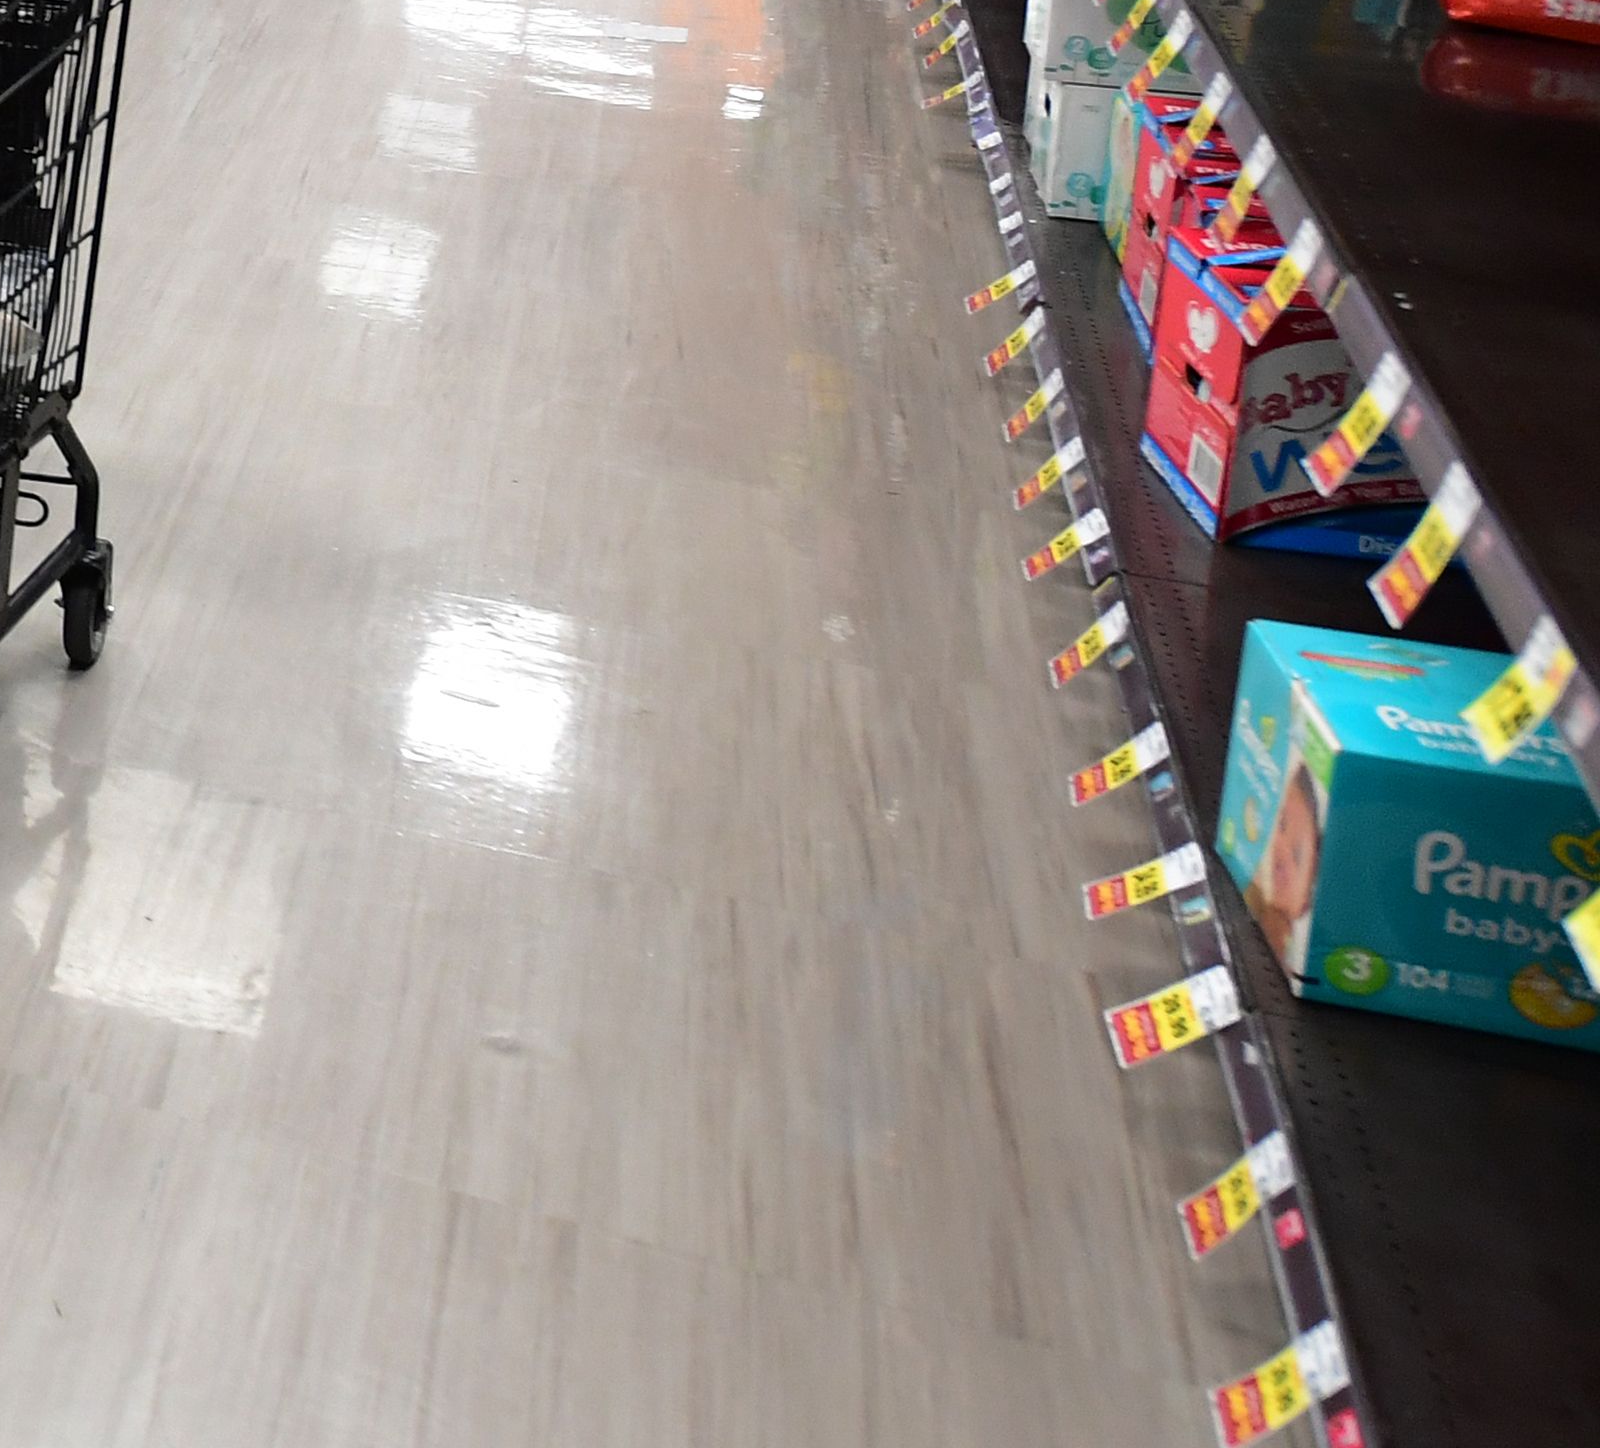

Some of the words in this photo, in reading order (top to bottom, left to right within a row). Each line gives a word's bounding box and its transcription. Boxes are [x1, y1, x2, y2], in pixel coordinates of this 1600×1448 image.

[1414, 830, 1591, 924] Pamp
[1341, 951, 1372, 982] 3
[1398, 962, 1449, 992] 104
